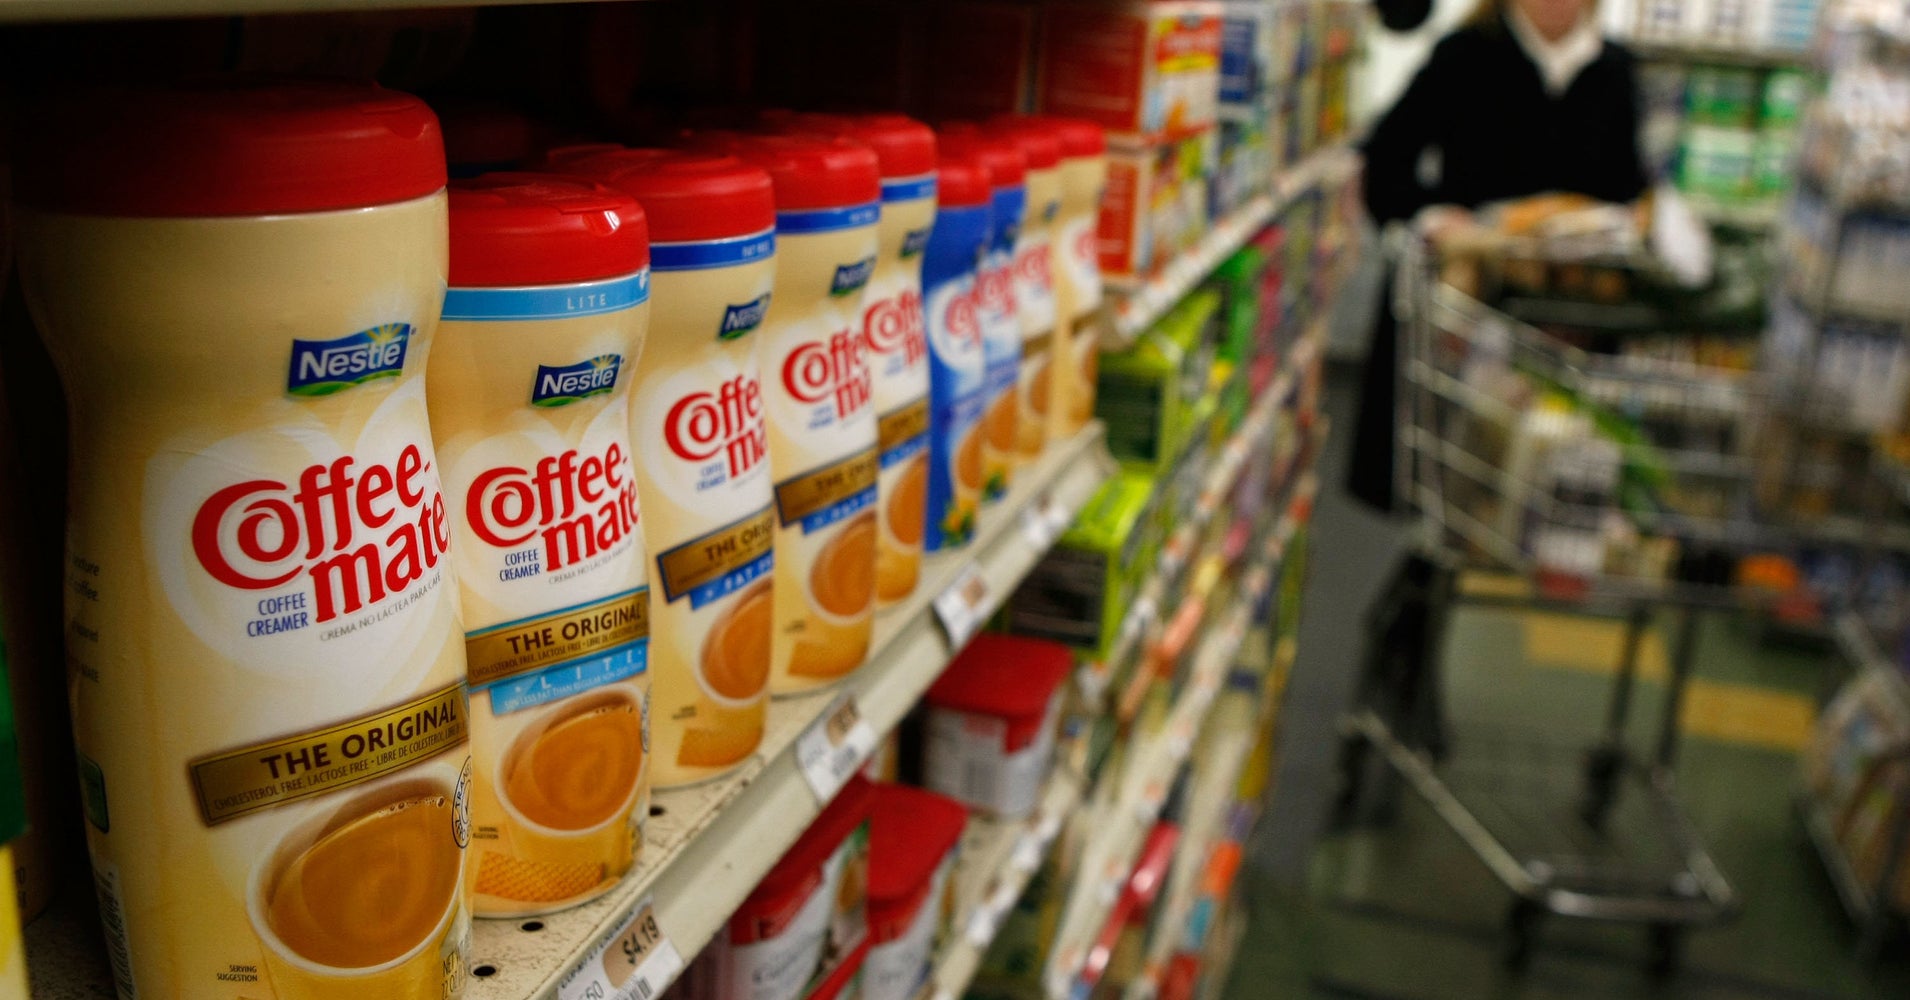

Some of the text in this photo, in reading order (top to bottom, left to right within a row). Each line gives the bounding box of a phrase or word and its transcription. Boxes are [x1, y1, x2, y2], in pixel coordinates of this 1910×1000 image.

[566, 294, 607, 310] LITE
[540, 479, 640, 572] mate
[308, 491, 448, 623] mate
[504, 548, 539, 567] COFFEE
[499, 563, 541, 582] CREAMER
[258, 592, 306, 616] COFFEE
[319, 623, 358, 642] CREMA
[359, 615, 376, 629] NO
[410, 587, 428, 605] PARA
[247, 611, 309, 638] CREAMER
[505, 627, 555, 655] THE
[561, 602, 642, 641] ORIGINAL
[538, 646, 566, 662] LACTOSE
[567, 641, 581, 653] FREE
[540, 649, 633, 690] LITE
[537, 689, 551, 700] FAT
[552, 683, 572, 697] THAN
[259, 698, 457, 779] THE ORIGINAL
[213, 785, 279, 811] CHOLESTEROL
[308, 766, 347, 786] LACTOSE
[350, 758, 369, 774] FREE
[376, 751, 397, 766] LIBRE
[399, 746, 408, 758] DE
[622, 915, 660, 965] $4.19
[216, 972, 258, 982] SUGGESTION
[229, 964, 257, 973] SERVING
